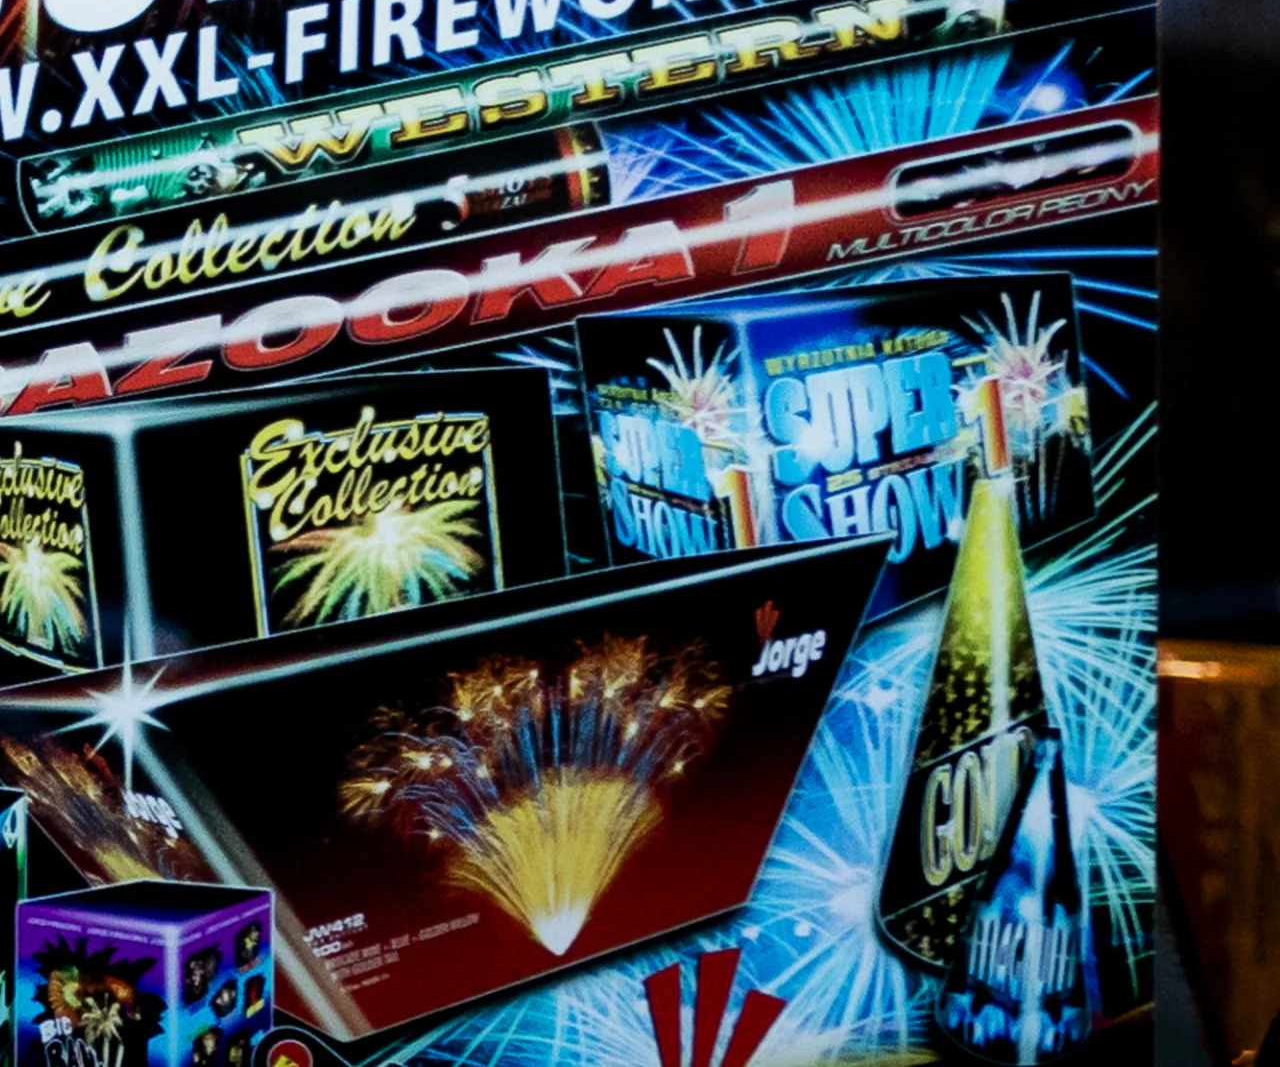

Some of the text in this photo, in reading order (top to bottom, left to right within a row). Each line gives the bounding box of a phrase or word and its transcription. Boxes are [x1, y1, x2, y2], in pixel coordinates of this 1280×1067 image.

[84, 196, 417, 302] Collection
[724, 179, 796, 276] 1
[825, 178, 1155, 262] MULTICOLOR PEONY
[249, 405, 490, 511] Exclusive
[765, 351, 959, 487] SUPER
[269, 462, 485, 542] Collection
[782, 458, 965, 565] SHOW
[752, 629, 827, 678] Jorge
